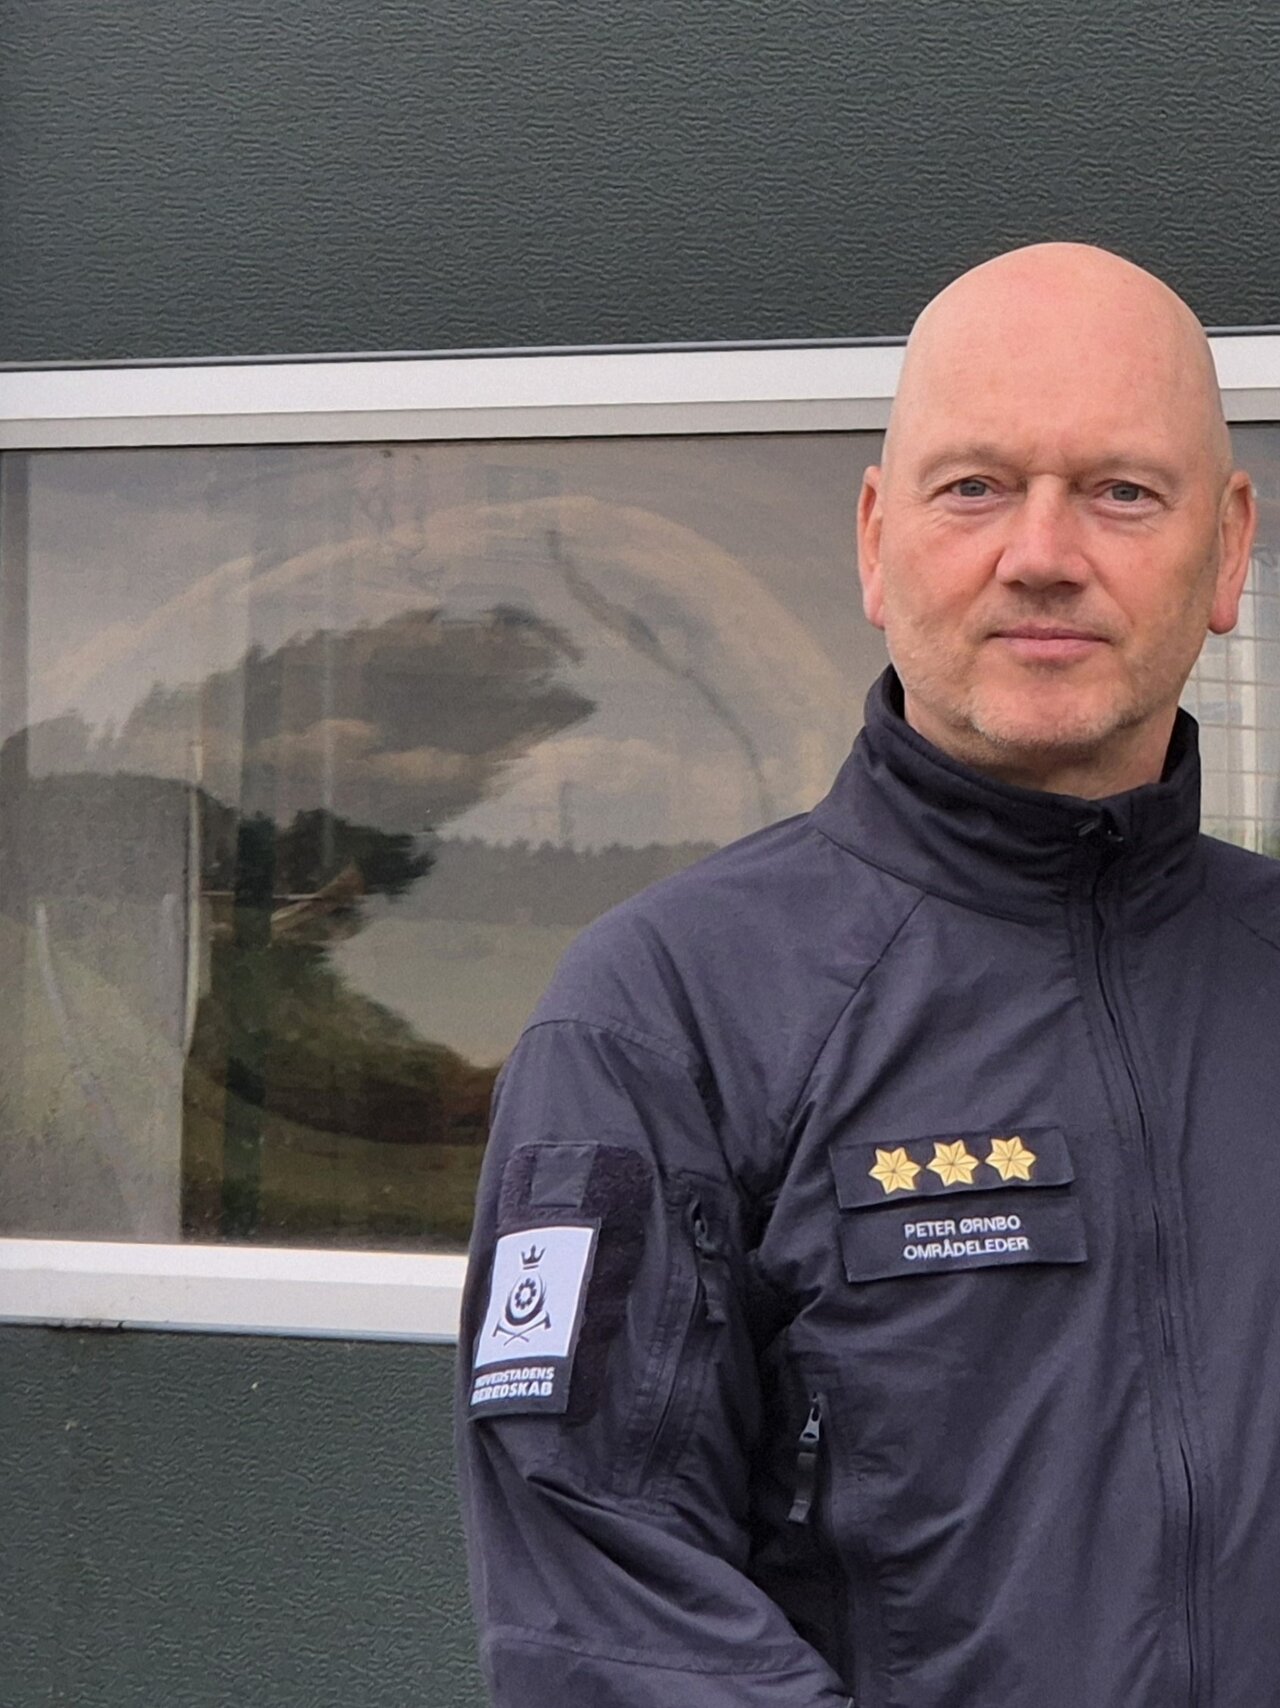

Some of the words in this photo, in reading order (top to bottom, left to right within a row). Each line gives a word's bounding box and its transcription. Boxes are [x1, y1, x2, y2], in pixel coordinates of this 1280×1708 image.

[904, 1219, 956, 1239] PETER
[959, 1215, 1021, 1235] ØRNBO
[903, 1236, 1030, 1260] OMRÅDELEDER
